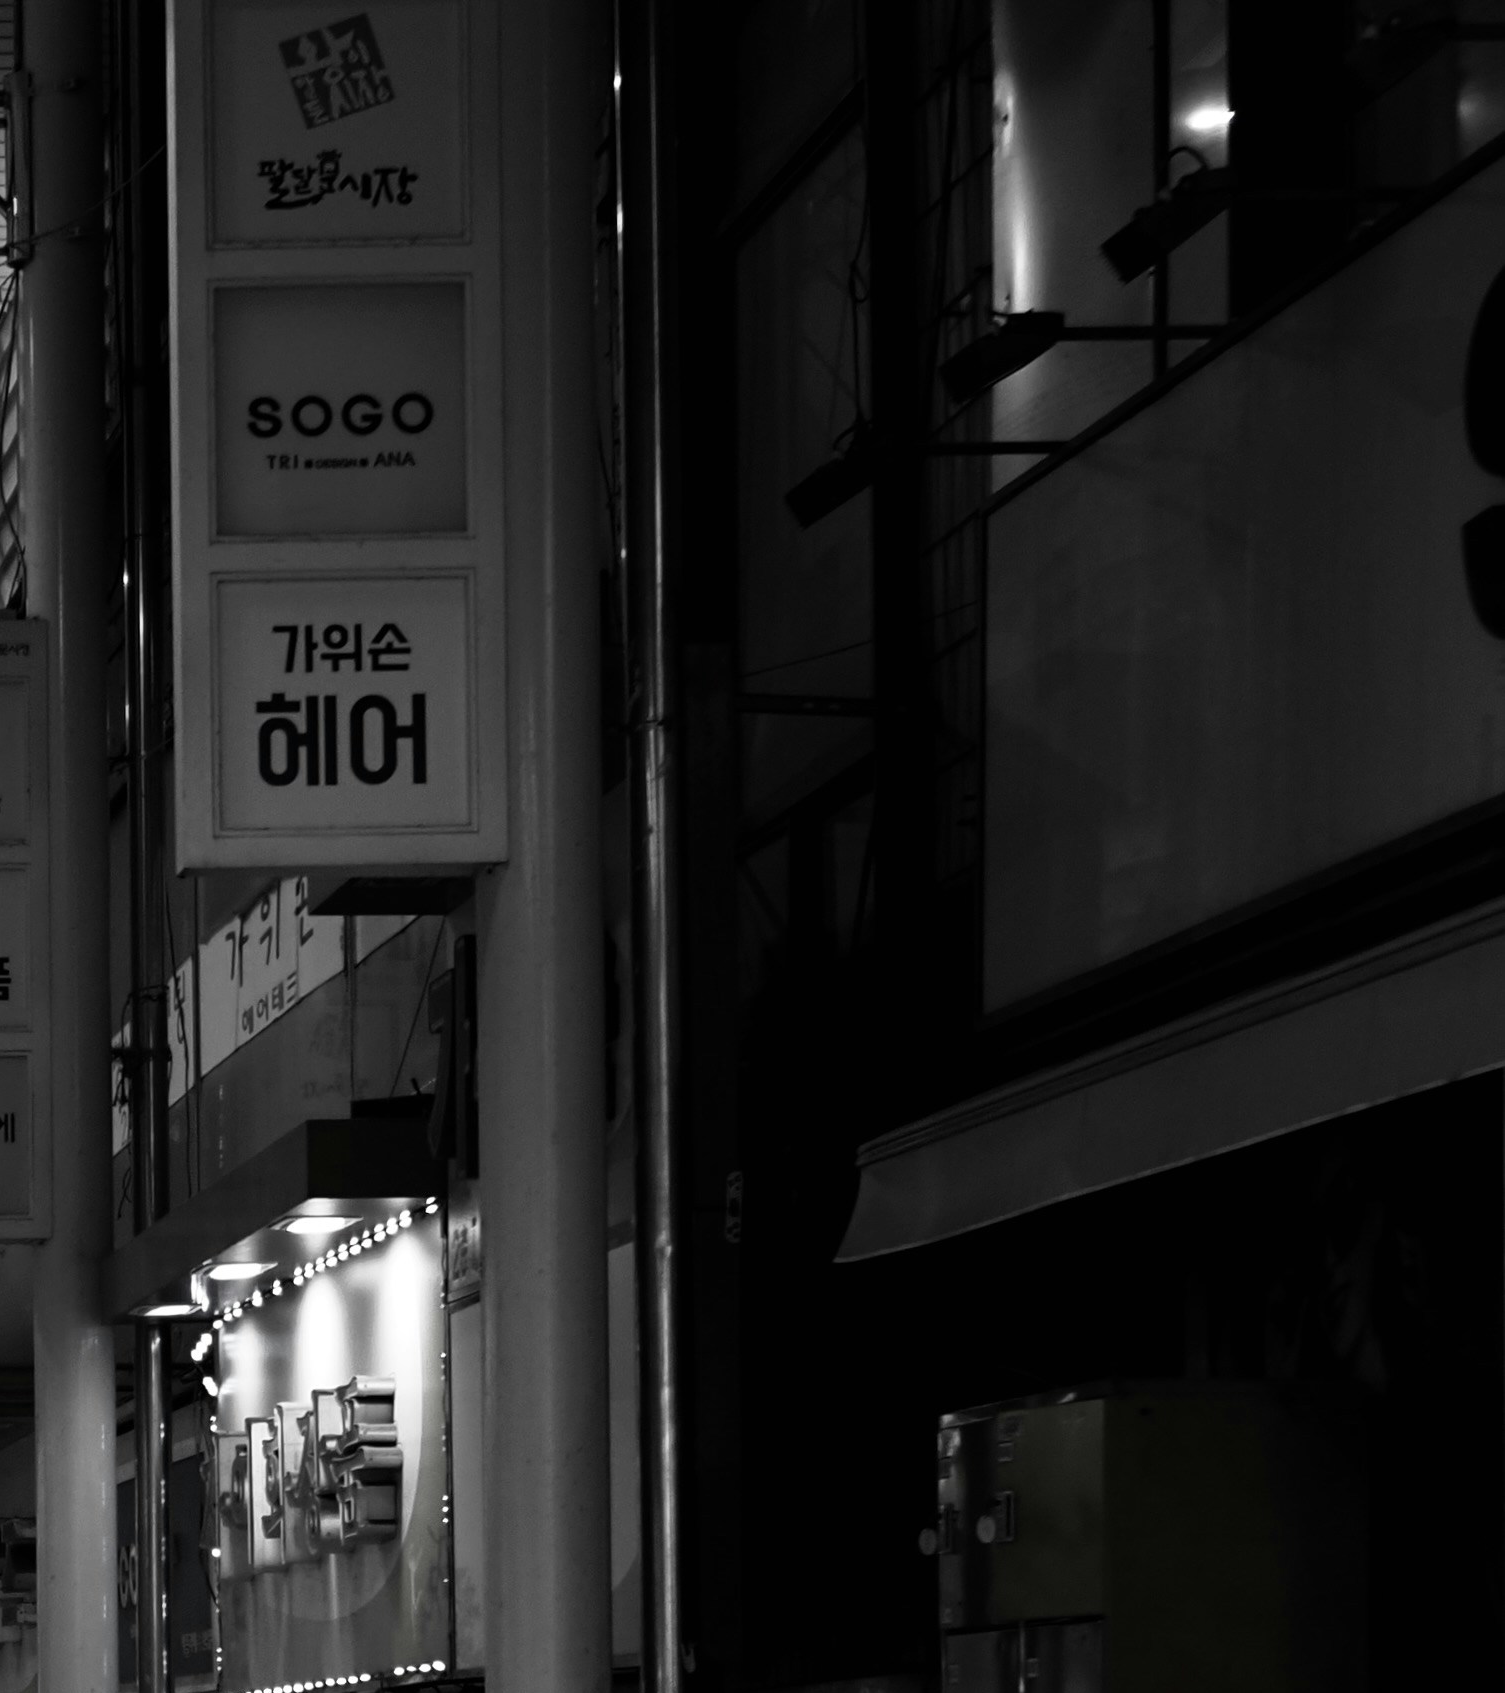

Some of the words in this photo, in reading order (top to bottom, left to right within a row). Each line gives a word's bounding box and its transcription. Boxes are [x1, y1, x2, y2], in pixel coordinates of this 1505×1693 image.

[257, 150, 420, 210] 팔달문시장
[247, 393, 434, 438] SOGO
[266, 455, 299, 470] TRI
[374, 451, 416, 468] ANA
[273, 623, 411, 672] 가위손
[255, 693, 428, 786] 헤어
